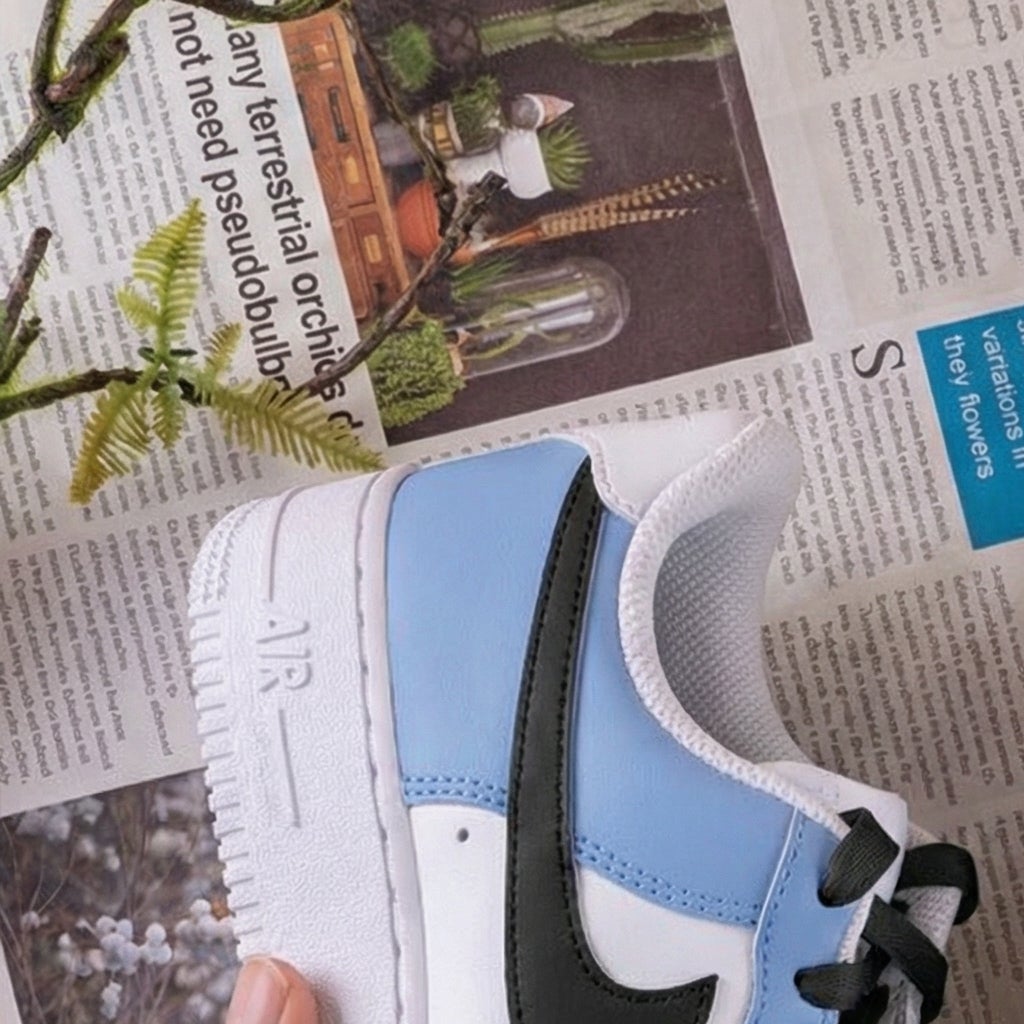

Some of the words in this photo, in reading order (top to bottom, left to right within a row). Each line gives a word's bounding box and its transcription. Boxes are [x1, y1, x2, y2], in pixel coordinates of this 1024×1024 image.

[168, 11, 214, 71] not
[186, 75, 239, 162] need
[223, 20, 267, 89] any
[245, 96, 319, 265] terrestrial
[943, 334, 970, 386] they
[981, 326, 1023, 441] variations
[255, 608, 313, 692] AIR
